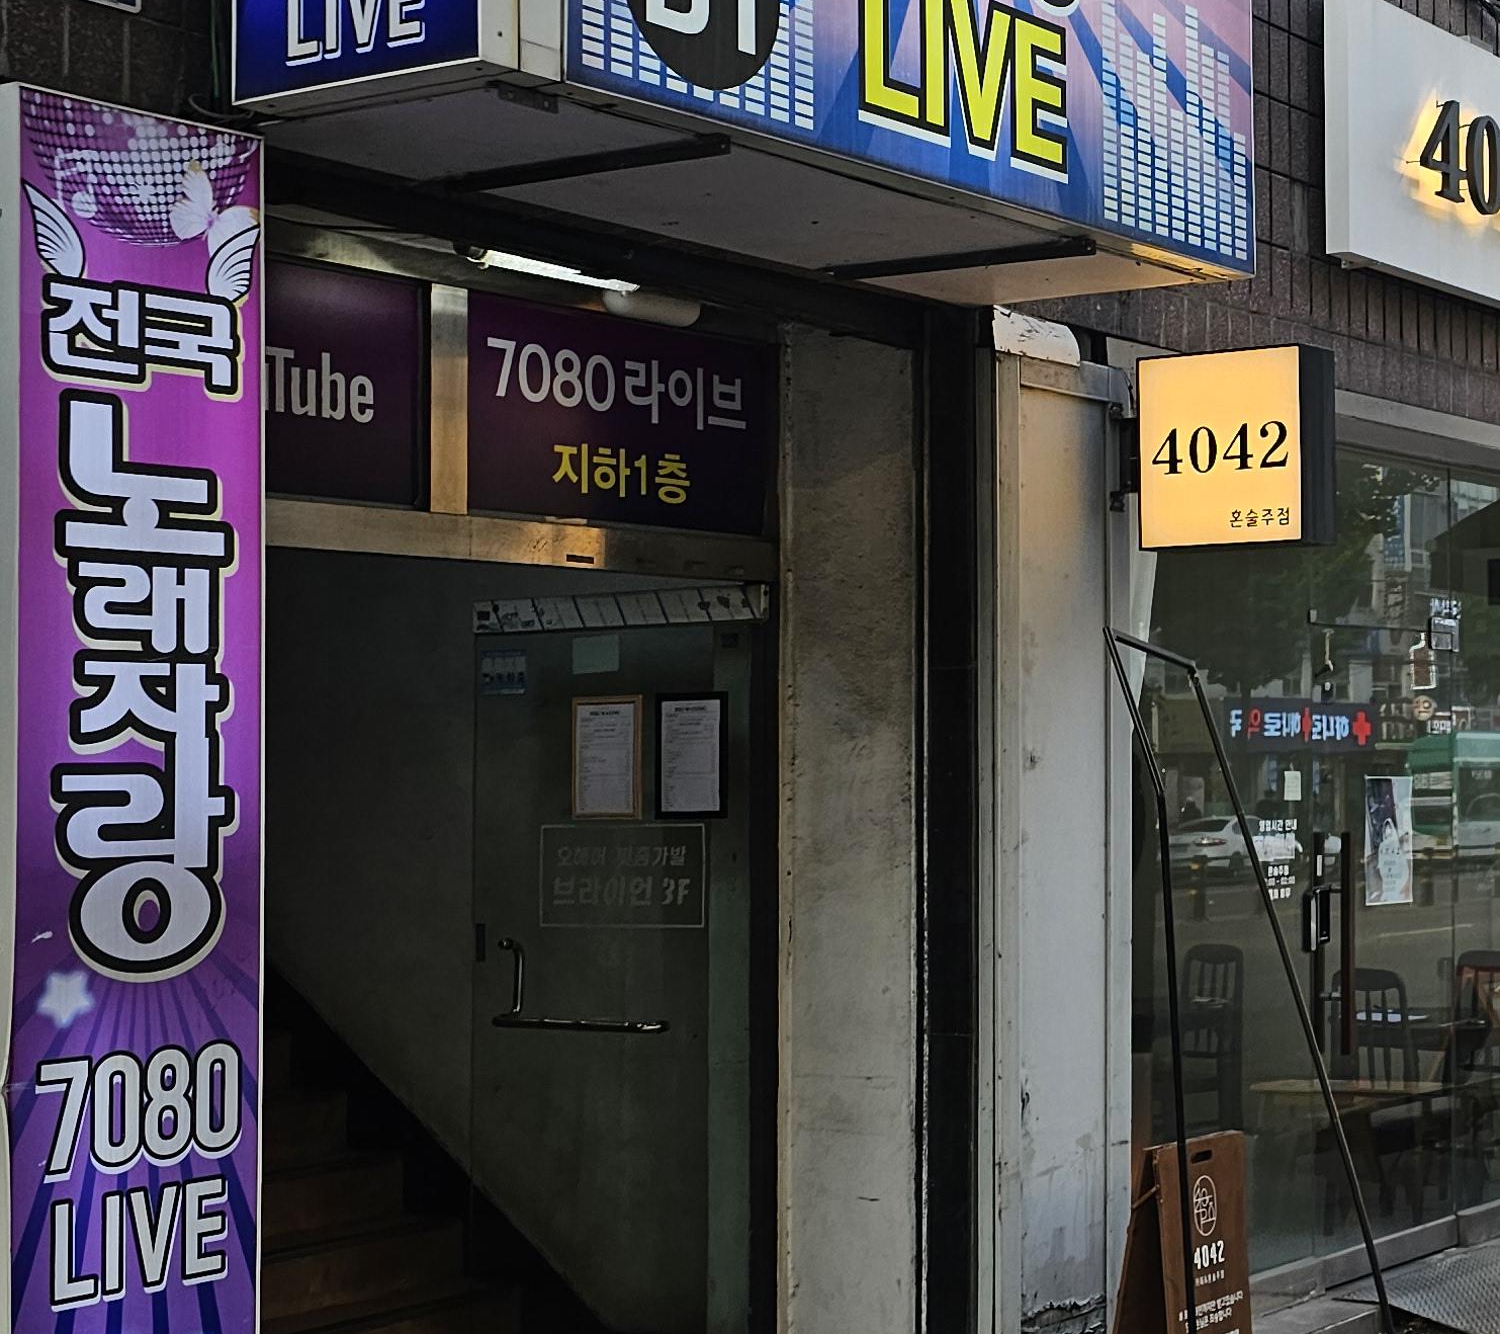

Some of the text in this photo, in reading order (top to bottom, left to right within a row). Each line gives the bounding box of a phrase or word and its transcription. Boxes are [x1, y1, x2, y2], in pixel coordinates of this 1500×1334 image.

[553, 443, 691, 505] 지하1층
[1151, 419, 1290, 475] 4042
[1228, 508, 1291, 528] 혼술주점
[48, 281, 236, 972] 전국 노래자랑
[661, 878, 691, 906] 3F
[35, 1043, 241, 1181] 7080
[50, 1178, 228, 1310] LIVE
[1194, 1240, 1225, 1269] 4042
